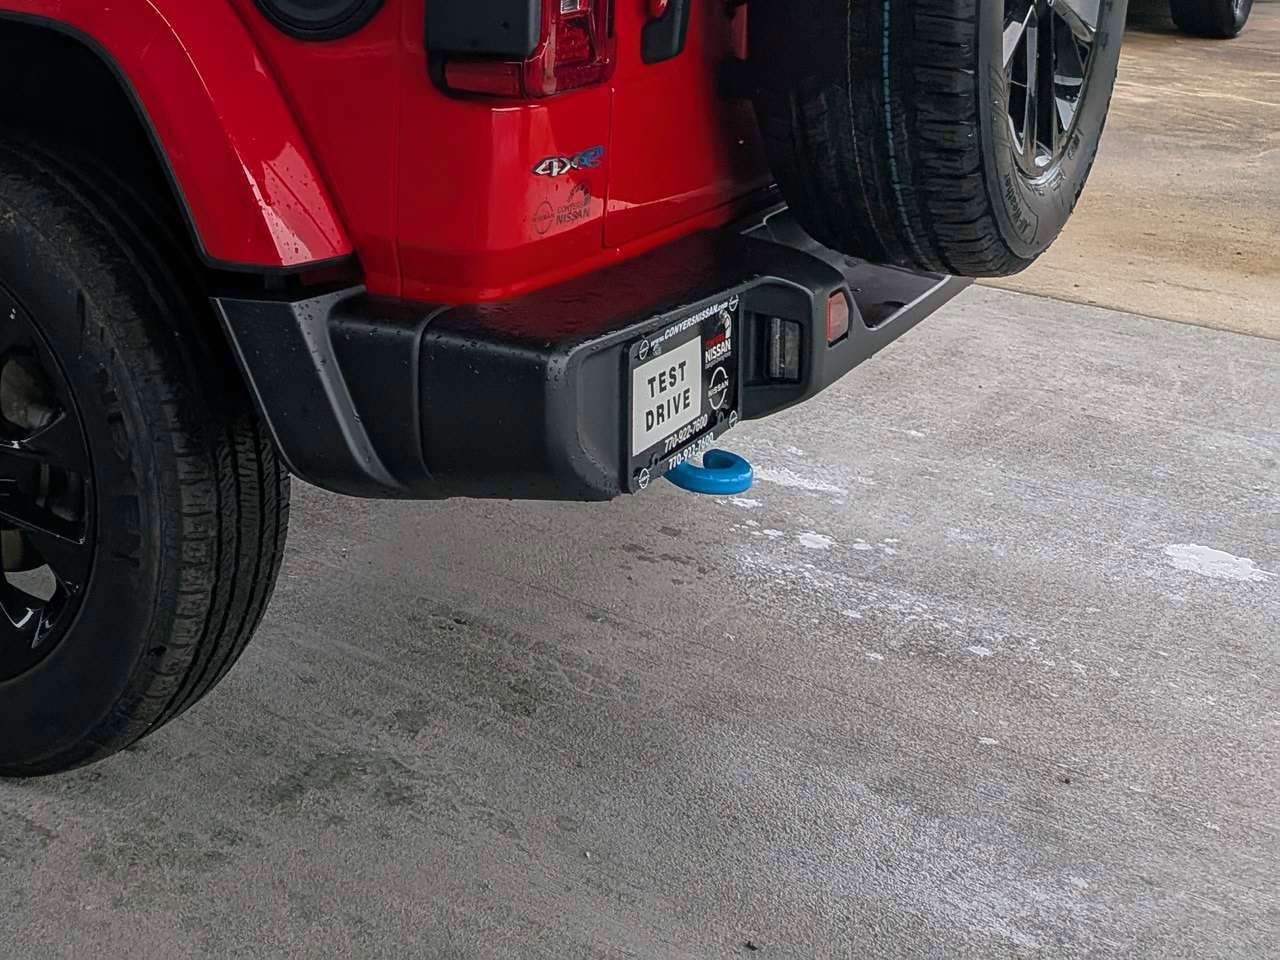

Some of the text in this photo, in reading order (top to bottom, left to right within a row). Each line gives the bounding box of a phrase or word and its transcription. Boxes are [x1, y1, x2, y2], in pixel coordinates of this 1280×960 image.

[556, 207, 590, 225] NISSAN
[705, 338, 731, 363] NISSAN
[647, 360, 687, 399] TEST
[708, 379, 729, 398] NISSAN
[645, 387, 691, 433] DRIVE
